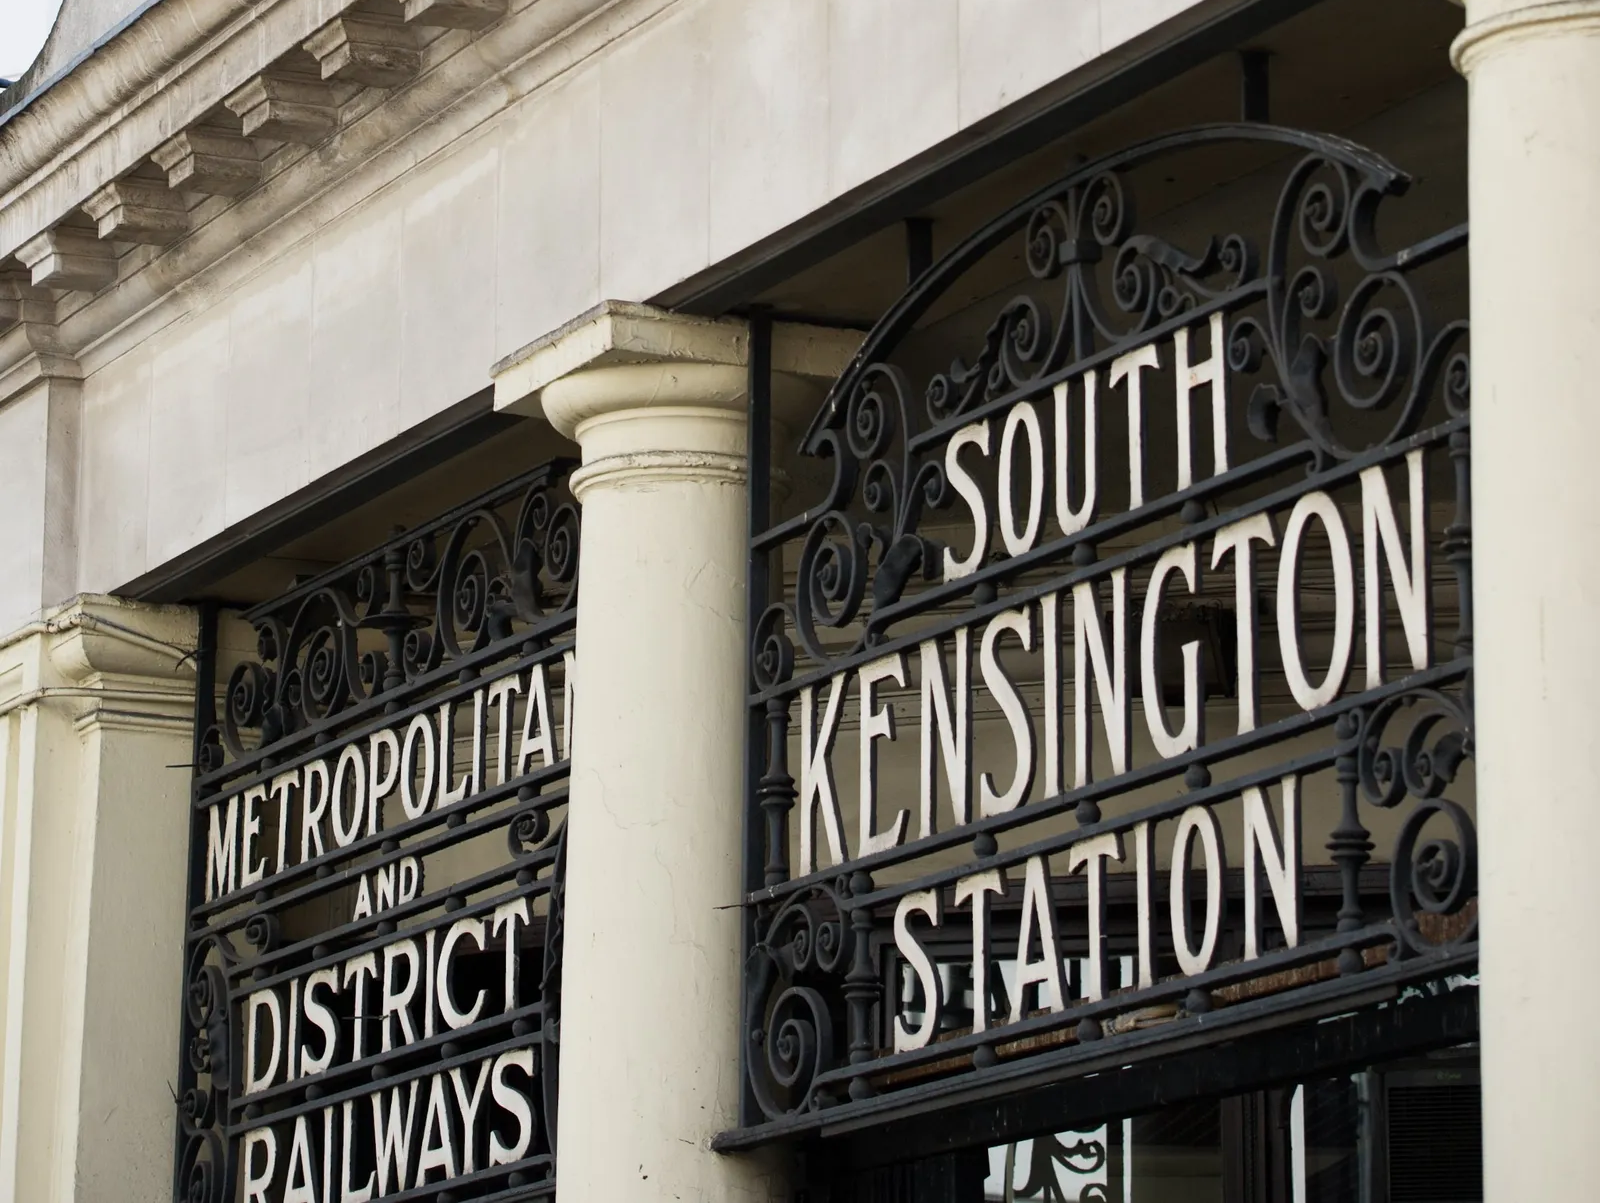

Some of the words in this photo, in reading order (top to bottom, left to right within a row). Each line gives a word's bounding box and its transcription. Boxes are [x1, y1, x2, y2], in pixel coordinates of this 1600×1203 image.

[943, 311, 1229, 583] SOUTH
[799, 449, 1430, 878] KENSINGTON
[245, 898, 530, 1096] DISTRICT
[352, 856, 420, 922] AND
[893, 773, 1299, 1054] STATION
[243, 1048, 535, 1203] RAILWAYS
